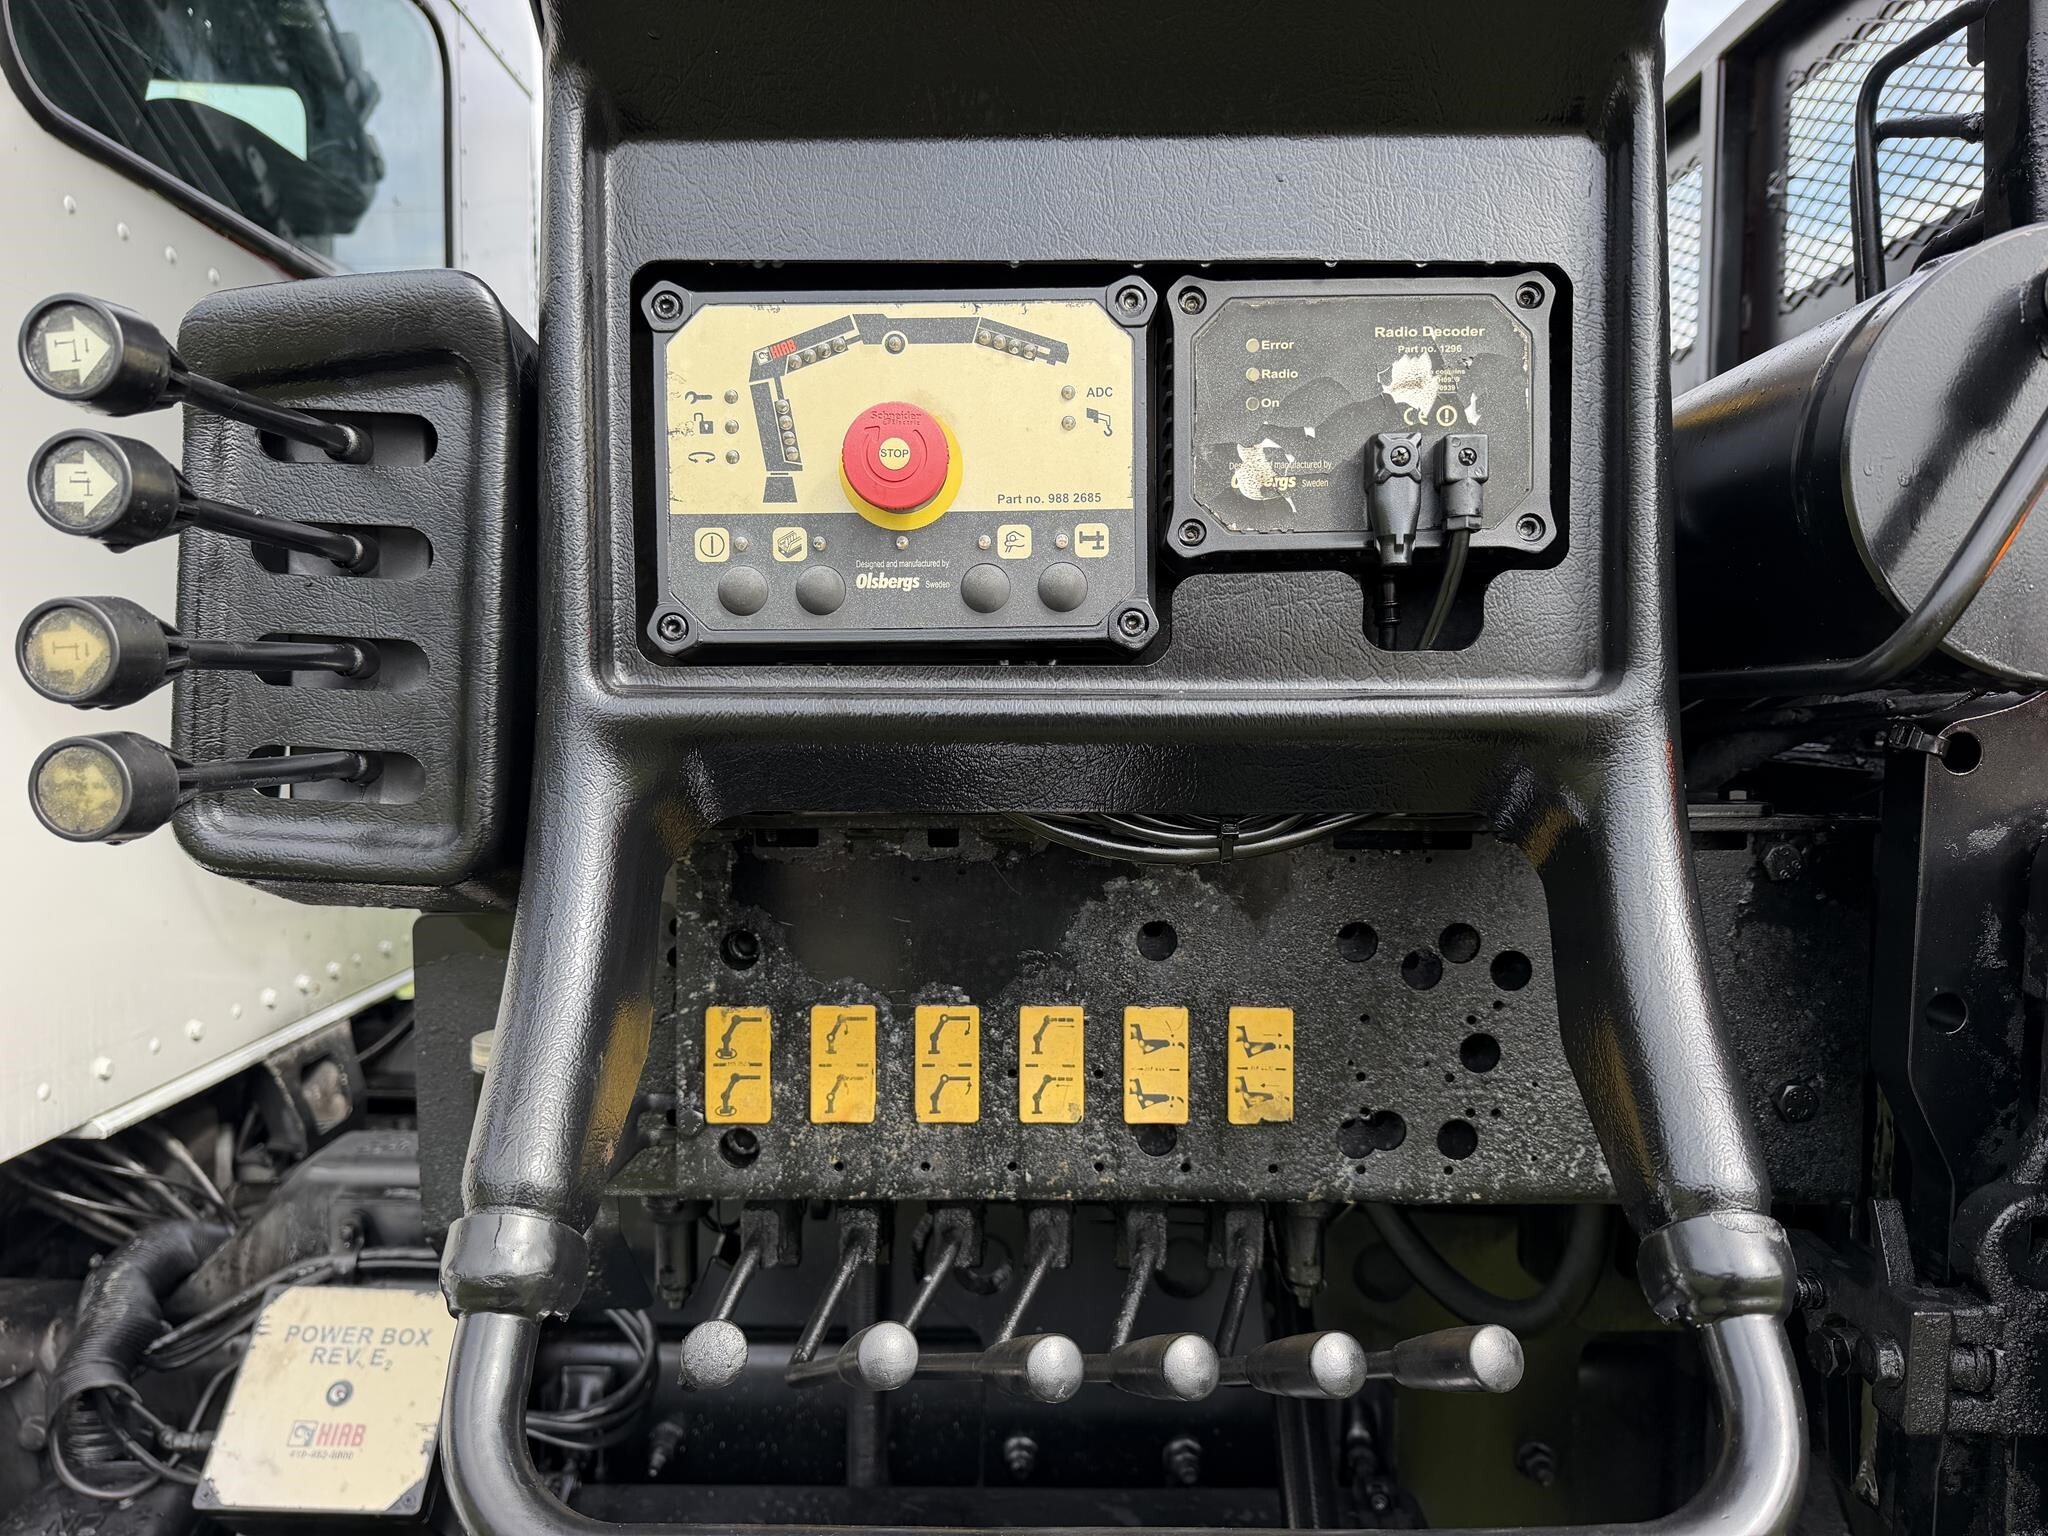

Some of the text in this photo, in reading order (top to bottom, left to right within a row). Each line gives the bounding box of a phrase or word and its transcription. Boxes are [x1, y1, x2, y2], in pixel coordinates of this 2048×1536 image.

[1374, 325, 1486, 338] Radio Decoder
[770, 338, 797, 359] HIAB
[1261, 340, 1295, 350] Error
[1397, 344, 1462, 353] Part no. 1296
[1261, 368, 1299, 379] Radio
[1086, 387, 1113, 398] ADC
[1260, 398, 1280, 408] On
[880, 448, 909, 458] STOP
[1323, 460, 1332, 470] by
[1301, 479, 1329, 488] Sweden
[997, 492, 1102, 504] Part no. 988 2685
[855, 559, 950, 570] Designed and manufactured by
[855, 571, 951, 592] Olsbergs Sweden
[284, 1324, 433, 1346] POWER BOX
[316, 1423, 367, 1447] HIAB
